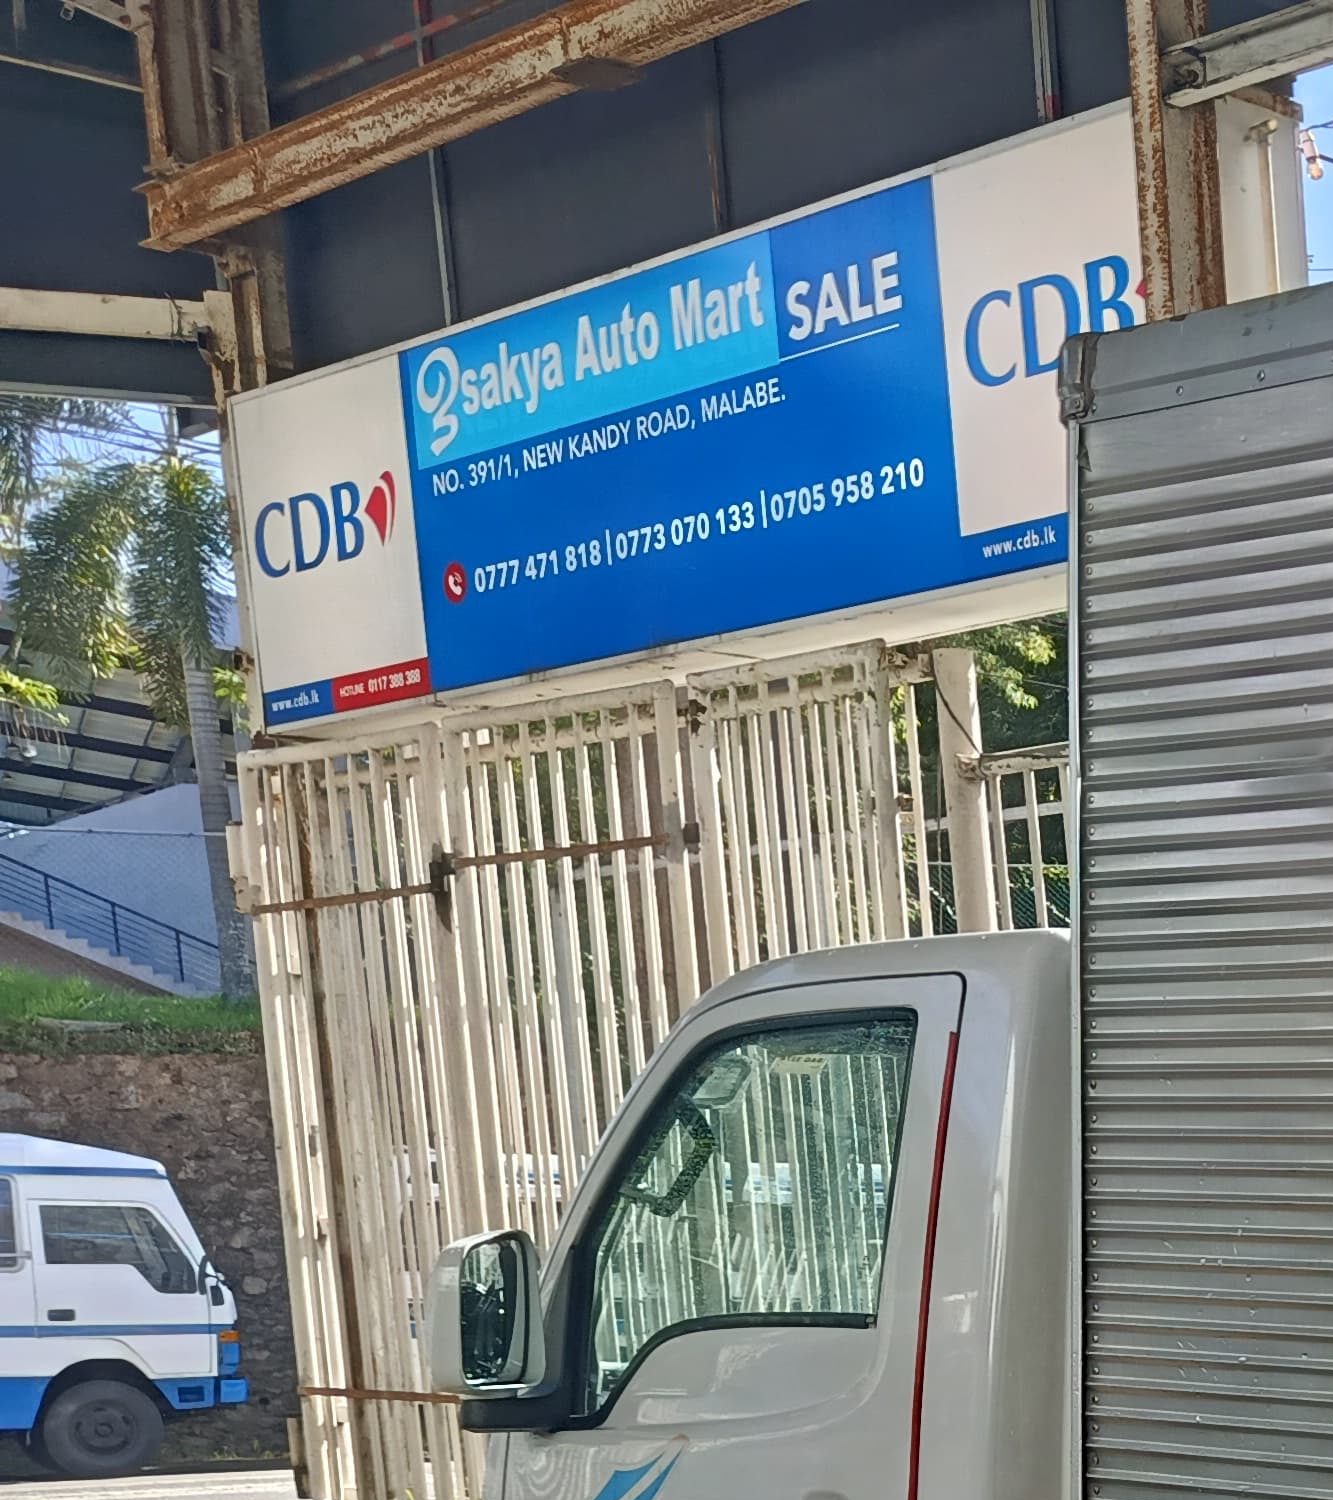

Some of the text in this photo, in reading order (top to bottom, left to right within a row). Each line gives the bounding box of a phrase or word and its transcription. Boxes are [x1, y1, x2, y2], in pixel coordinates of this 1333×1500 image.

[575, 302, 660, 381] Auto
[670, 261, 765, 351] Mart
[785, 251, 903, 341] SALE
[964, 255, 1135, 387] CDB
[432, 377, 786, 496] NO. 391/1, NEW KANDY ROAD, MALABE.
[254, 481, 366, 579] CDB
[474, 559, 520, 593] 0777
[525, 550, 559, 581] 471
[565, 540, 601, 573] 818
[615, 523, 666, 560] 0773
[671, 512, 710, 545] 070
[715, 502, 755, 535] 133
[831, 471, 874, 508] 958
[880, 458, 925, 494] 210
[982, 524, 1057, 559] www.cdb.lk
